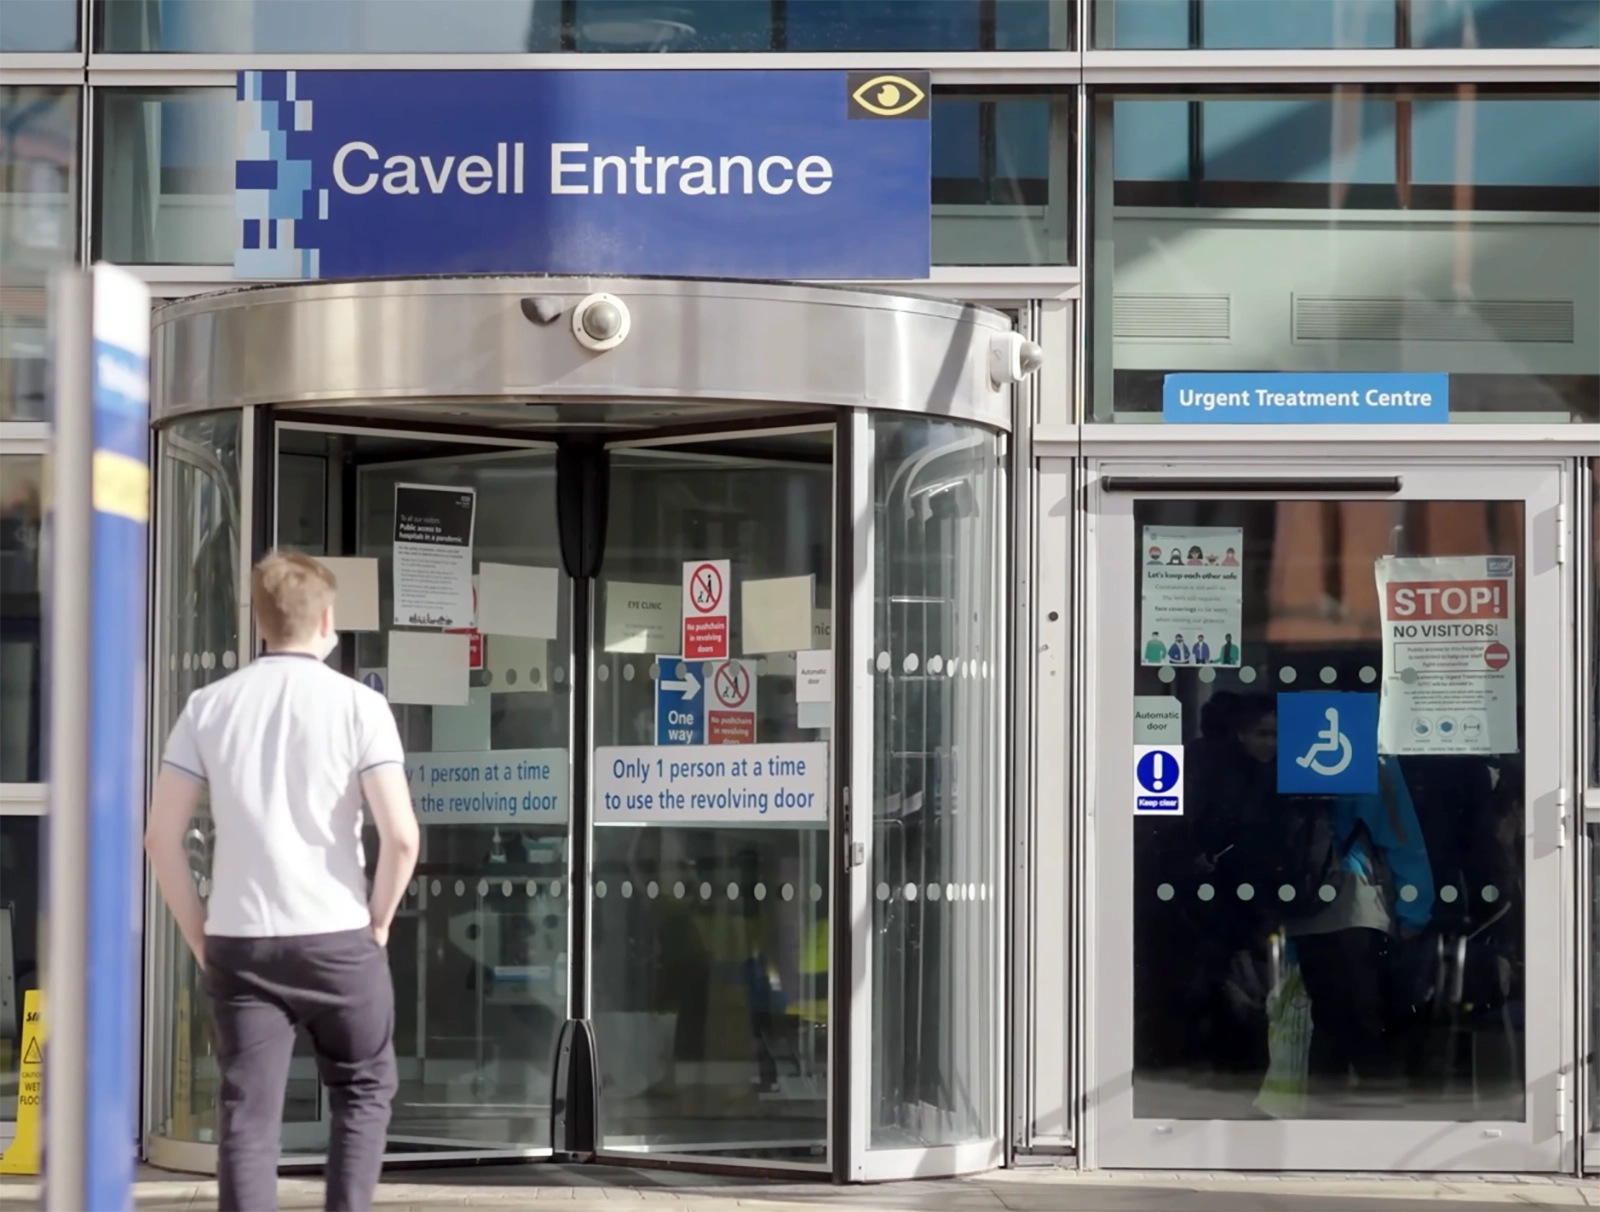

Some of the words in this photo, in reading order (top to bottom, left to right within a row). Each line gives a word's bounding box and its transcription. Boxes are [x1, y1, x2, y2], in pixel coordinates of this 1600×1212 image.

[332, 141, 524, 195] Cavell
[550, 142, 833, 195] Entrance
[1179, 389, 1250, 411] Urgent
[1255, 389, 1359, 407] Treatment
[1365, 389, 1432, 407] Centre
[400, 523, 416, 531] Public
[399, 531, 424, 541] hospitals
[435, 535, 463, 543] pandemic
[1165, 571, 1183, 580] keep
[1202, 572, 1221, 580] other
[1222, 572, 1237, 580] safe
[628, 600, 639, 609] EYE
[641, 601, 662, 610] CLINIC
[1394, 586, 1500, 616] STOP!
[695, 622, 724, 632] pushchairs
[1393, 625, 1417, 638] NO
[1421, 624, 1498, 637] VISITORS!
[696, 633, 721, 643] revolving
[807, 677, 820, 685] door
[668, 710, 694, 725] One
[1135, 711, 1179, 719] Automatic
[720, 716, 752, 725] pushchairs
[1147, 722, 1167, 730] door
[668, 729, 693, 744] way
[720, 727, 748, 737] revolving
[419, 764, 424, 782] 1
[431, 766, 479, 787] person
[485, 764, 499, 781] at
[504, 765, 512, 780] a
[517, 760, 550, 780] time
[613, 757, 650, 784] Only
[656, 758, 663, 778] 1
[669, 760, 725, 783] person
[731, 758, 748, 777] at
[753, 760, 762, 776] a
[768, 755, 806, 776] time
[421, 793, 444, 813] the
[450, 791, 517, 817] revolving
[522, 791, 557, 811] door
[605, 791, 621, 810] to
[627, 794, 653, 810] use
[658, 788, 685, 809] the
[690, 787, 768, 814] revolving
[774, 787, 815, 808] door
[1139, 798, 1158, 808] Keep
[1159, 798, 1177, 807] clear
[24, 1082, 41, 1091] WET
[20, 1095, 41, 1105] FLOO
